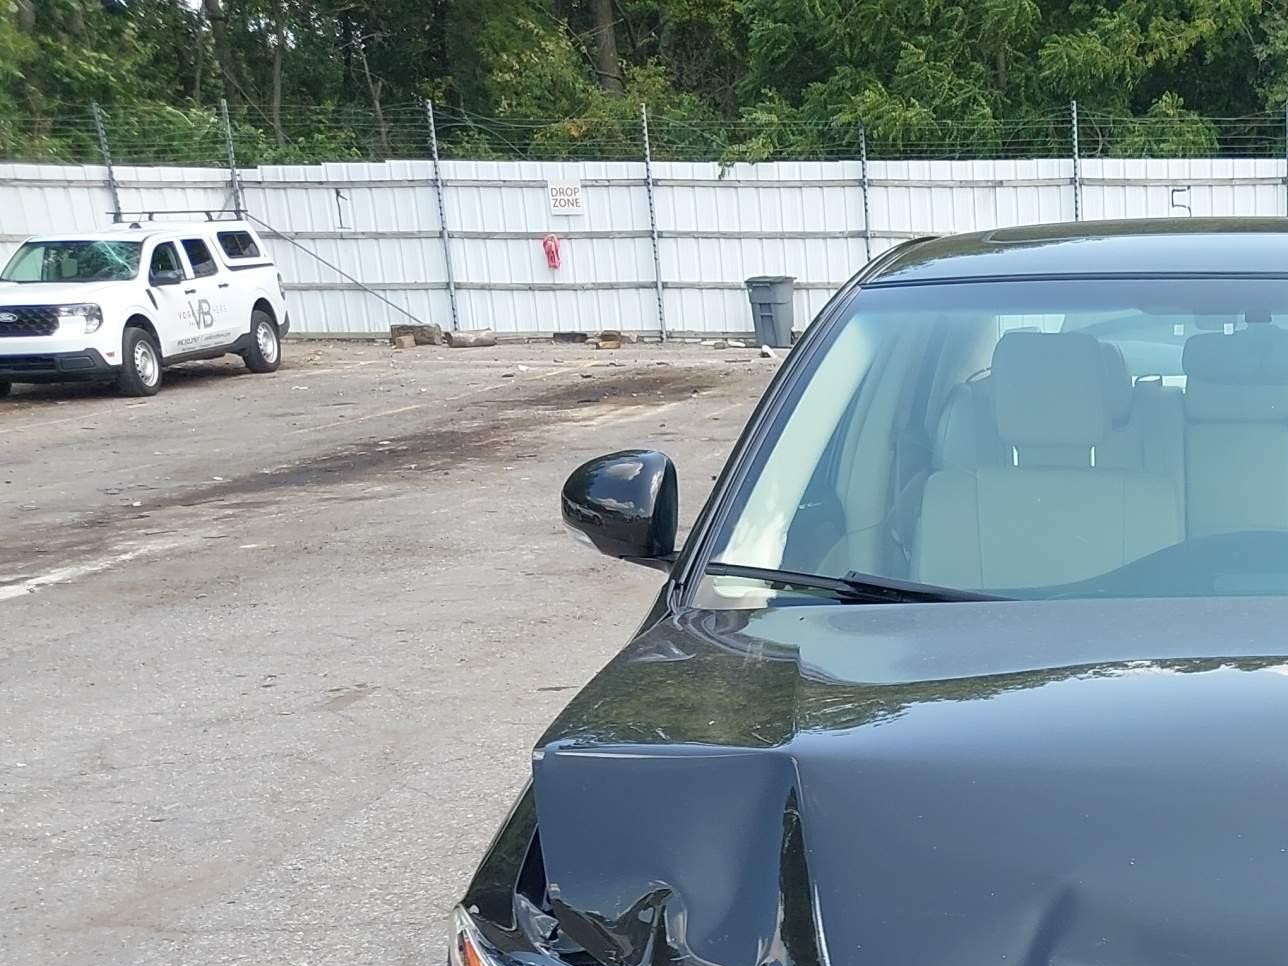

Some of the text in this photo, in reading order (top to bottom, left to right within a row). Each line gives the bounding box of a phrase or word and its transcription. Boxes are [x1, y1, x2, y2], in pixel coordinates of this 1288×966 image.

[550, 187, 580, 197] DROP
[551, 198, 582, 208] ZONE
[187, 298, 215, 331] VB
